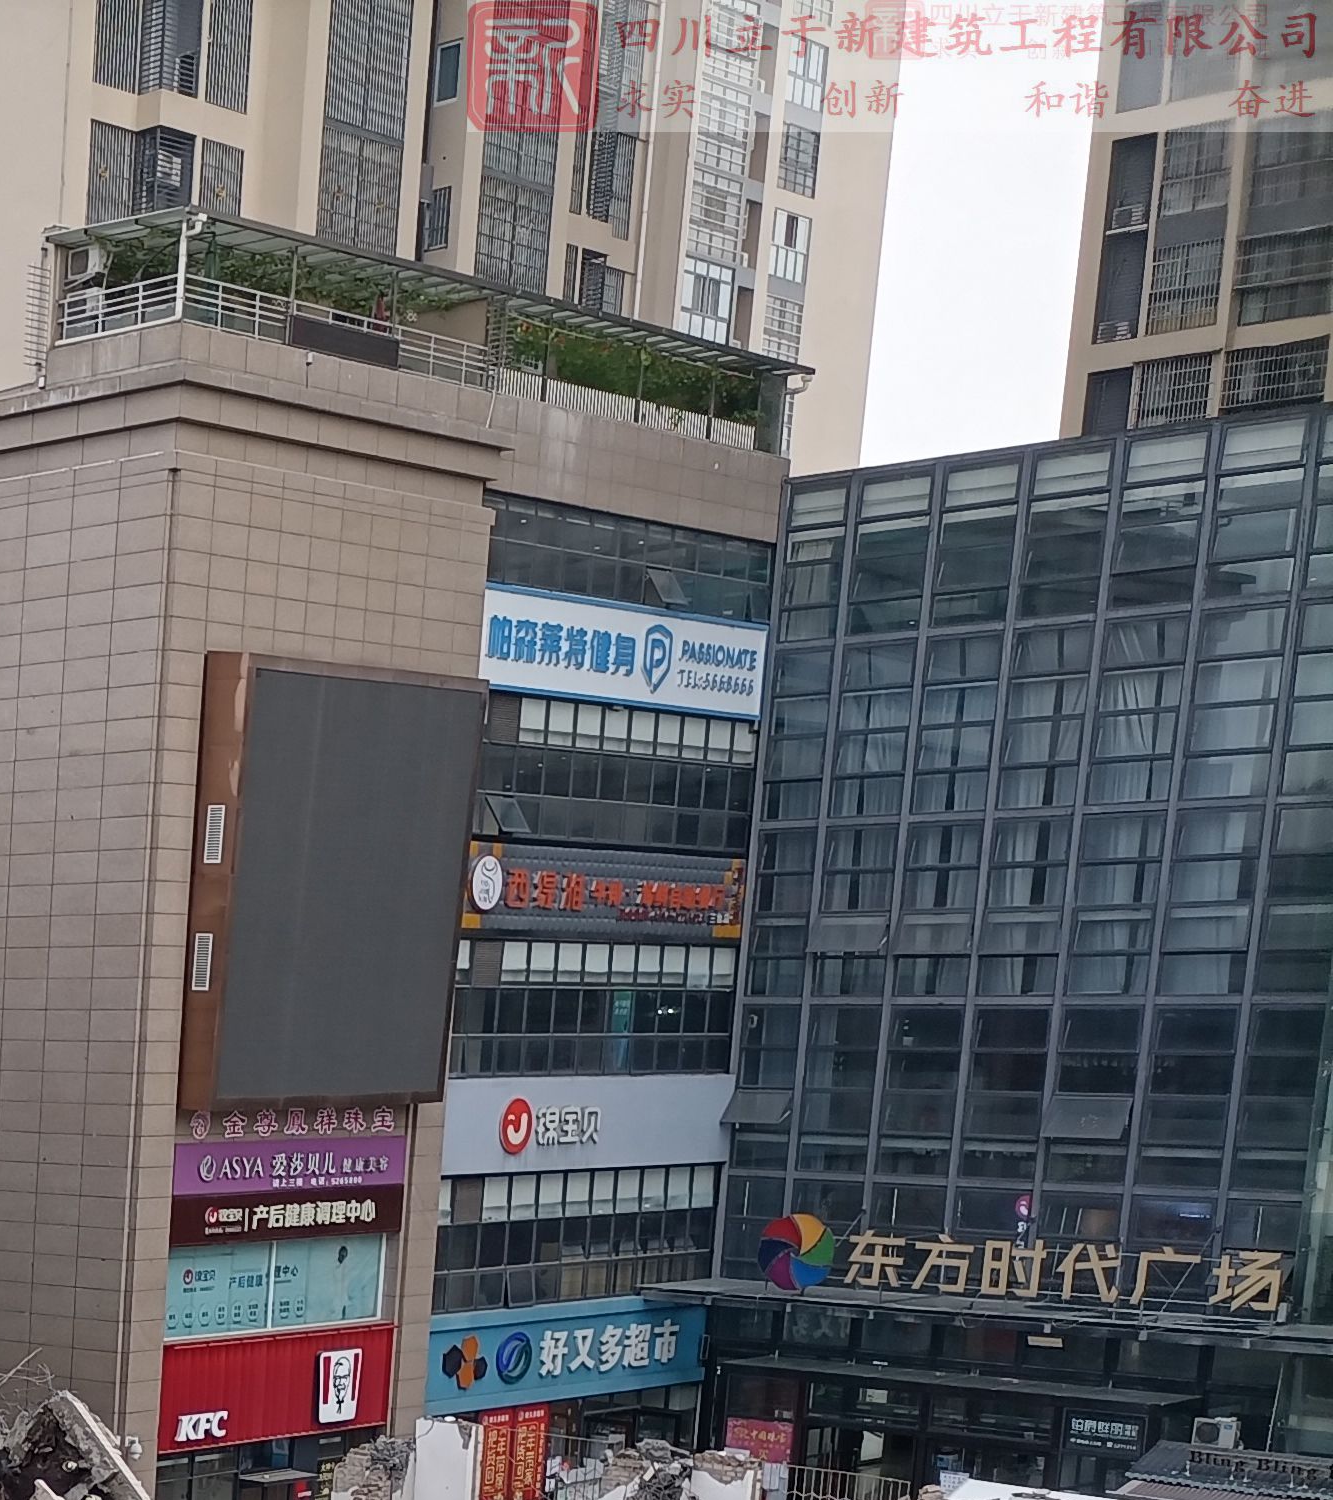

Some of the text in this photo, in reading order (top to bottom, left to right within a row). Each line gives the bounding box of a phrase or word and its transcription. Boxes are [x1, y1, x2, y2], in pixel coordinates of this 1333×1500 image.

[678, 639, 758, 672] PASSIONATE
[222, 1105, 395, 1139] 金尊鳳祥珠宝
[217, 1155, 264, 1180] ASYA
[271, 1151, 337, 1177] 爱莎贝儿
[251, 1198, 377, 1232] 产后健康调理中心
[844, 1229, 1283, 1313] 东方时代广场
[538, 1319, 680, 1378] 好又多超市
[174, 1410, 229, 1442] KFC
[1188, 1450, 1246, 1473] Bling
